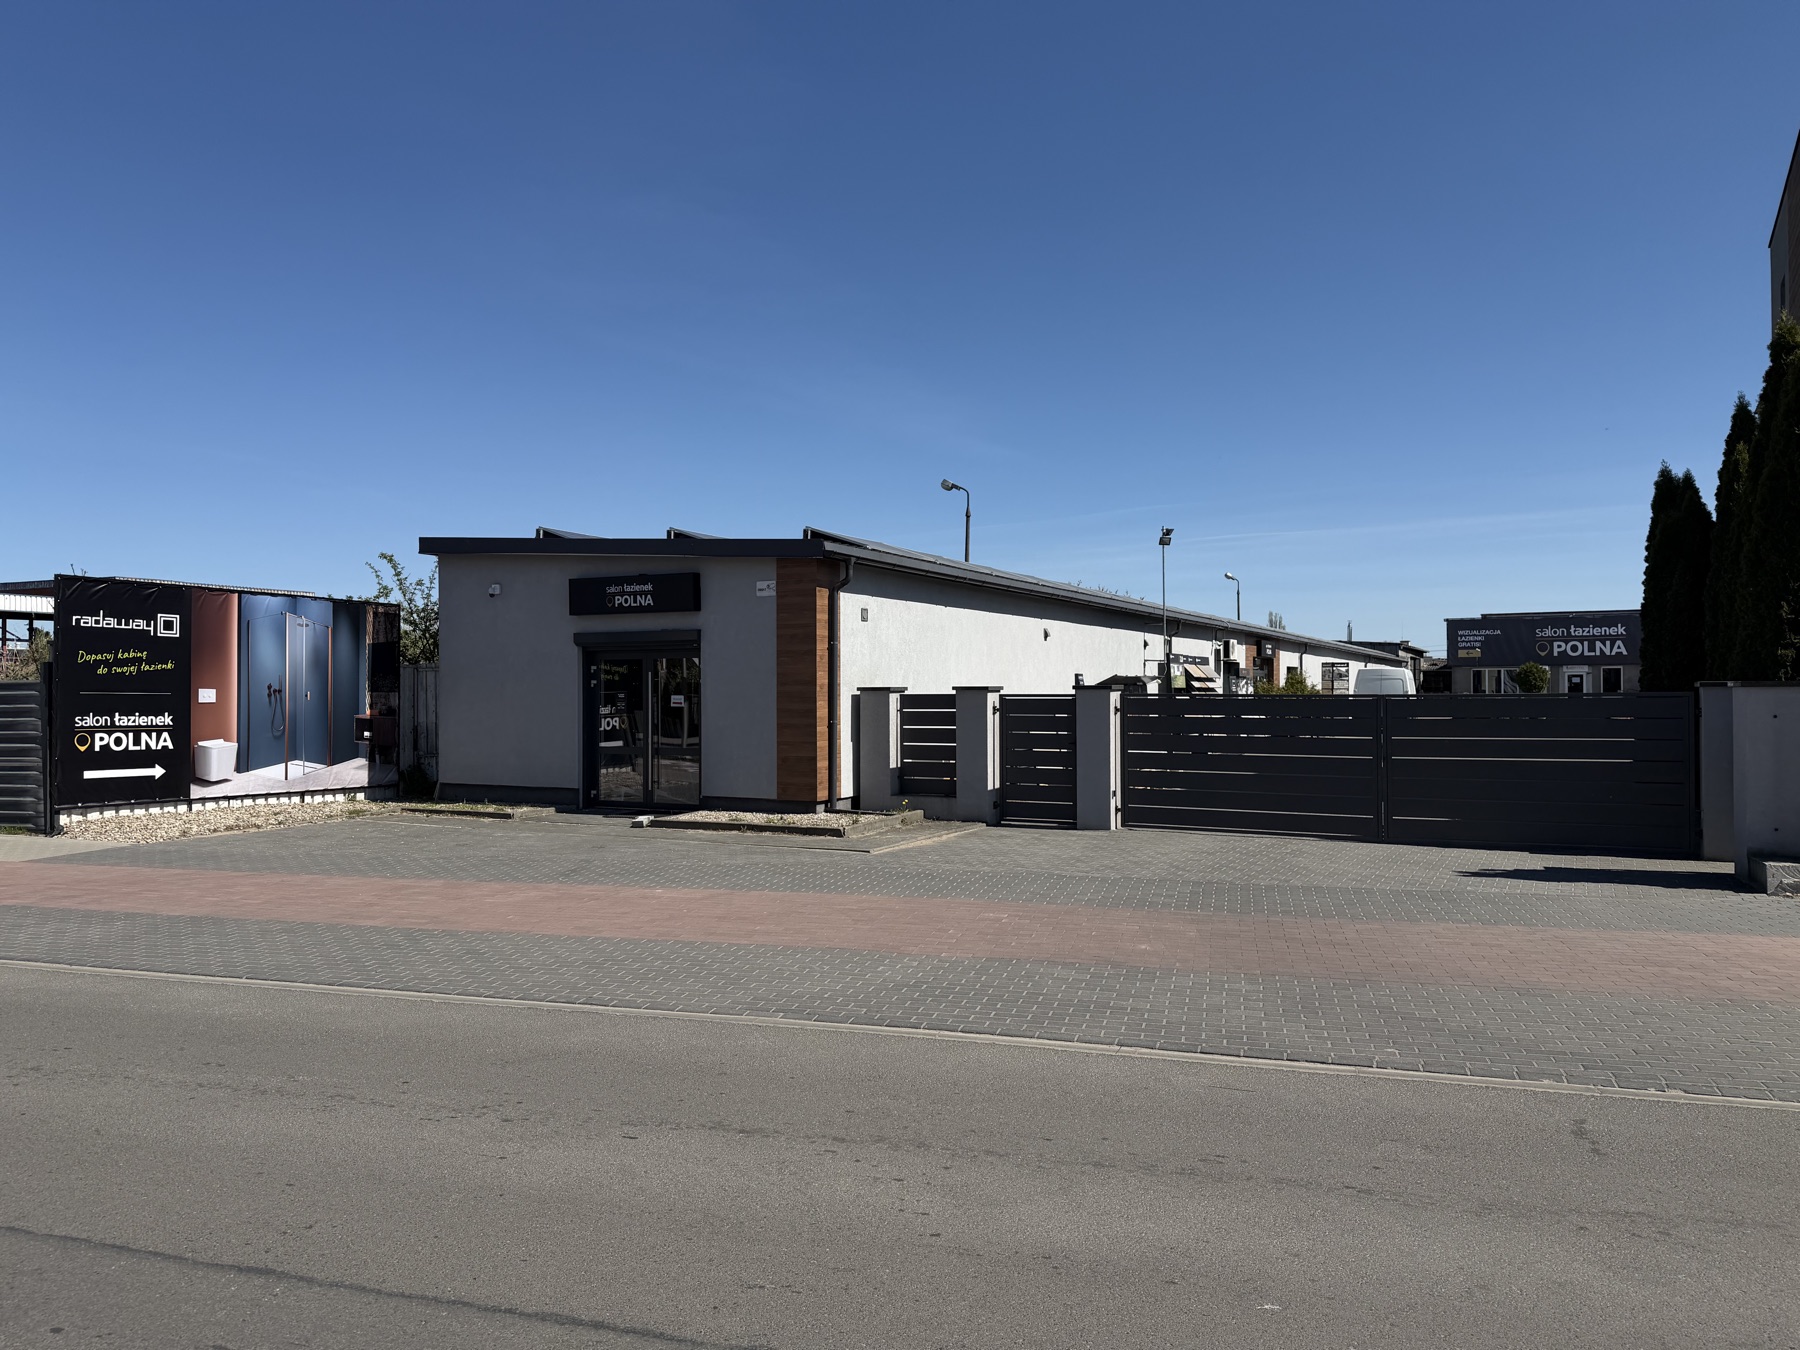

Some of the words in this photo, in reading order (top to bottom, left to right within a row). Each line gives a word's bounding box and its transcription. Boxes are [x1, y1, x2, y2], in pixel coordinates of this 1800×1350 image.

[606, 584, 623, 594] salon
[623, 582, 654, 592] łazienek
[615, 594, 654, 607] POLNA
[72, 610, 154, 636] radaway
[1535, 625, 1567, 637] salon
[1569, 623, 1627, 636] łazienek
[77, 650, 115, 663] Dopasuj
[117, 649, 148, 660] kabinę
[1553, 640, 1628, 657] POLNA
[96, 664, 108, 675] do
[111, 663, 138, 676] swojej
[141, 660, 175, 671] łazienki
[74, 712, 111, 727] salon
[114, 711, 174, 726] łazienek
[94, 731, 174, 752] POLNA
